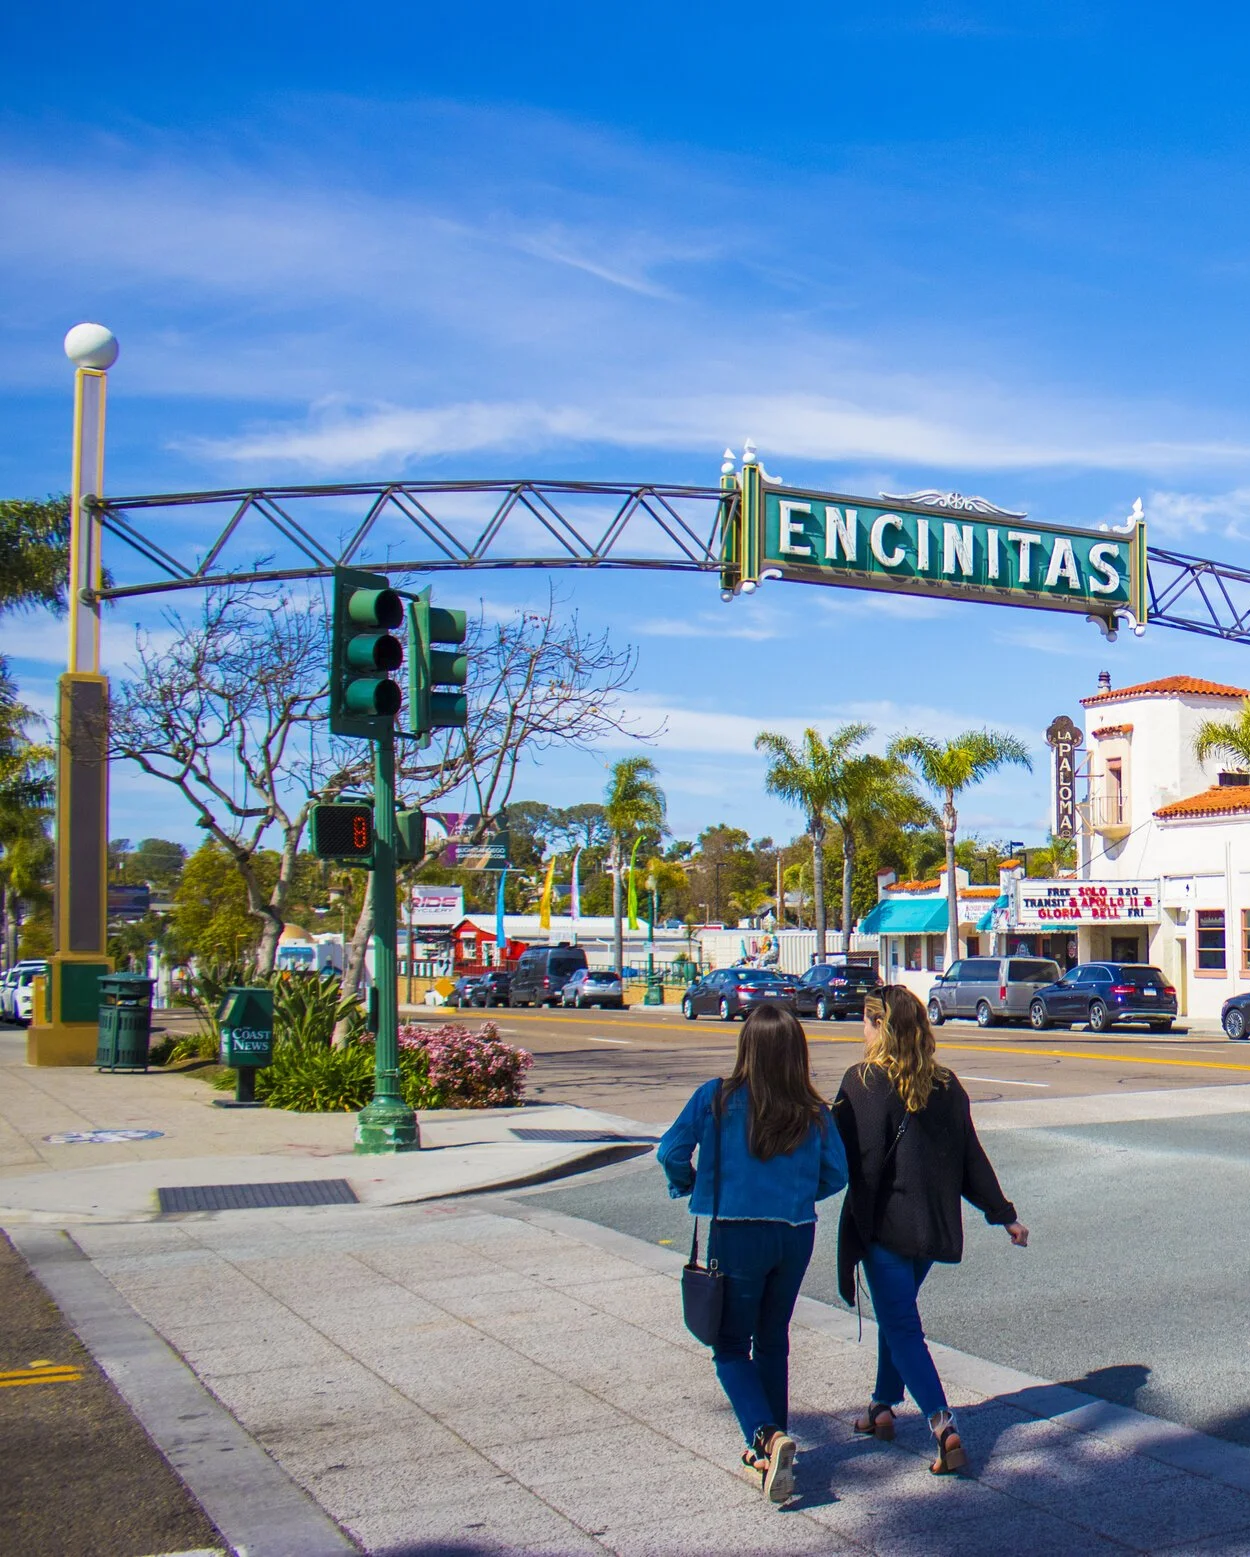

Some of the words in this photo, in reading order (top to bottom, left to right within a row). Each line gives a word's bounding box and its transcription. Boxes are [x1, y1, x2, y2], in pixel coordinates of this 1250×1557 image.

[778, 499, 1120, 595] ENCINITAS
[1057, 731, 1072, 740] LA
[1059, 743, 1073, 830] PALOMA
[353, 816, 367, 849] 8
[1047, 888, 1071, 897] FREE
[1078, 887, 1108, 897] SOLO
[411, 896, 458, 908] RIDE
[1023, 898, 1067, 908] TRANSIT
[1081, 897, 1125, 908] APOLLO
[1038, 908, 1082, 919] GLORIA
[1127, 908, 1145, 918] FRI
[231, 1027, 271, 1040] COAST
[233, 1039, 269, 1051] NEWS
